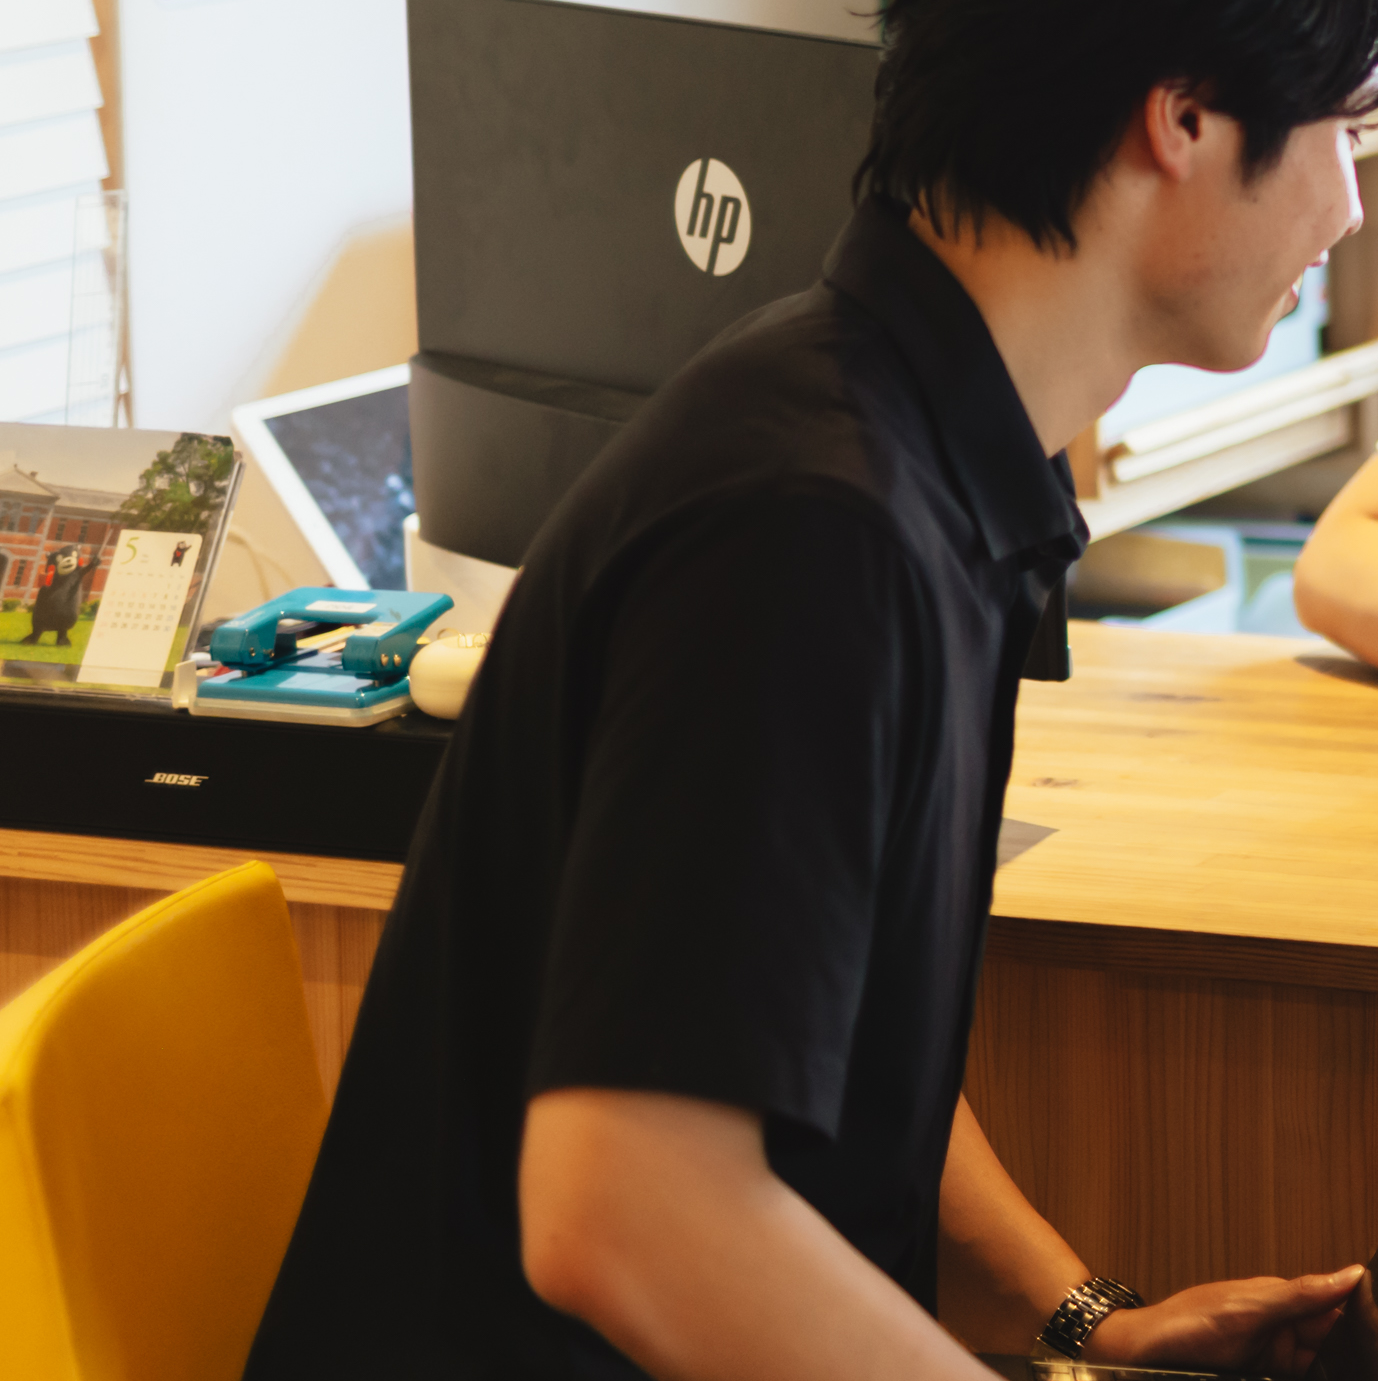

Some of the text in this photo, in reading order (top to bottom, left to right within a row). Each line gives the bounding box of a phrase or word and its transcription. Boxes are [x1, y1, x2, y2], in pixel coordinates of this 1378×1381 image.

[684, 157, 744, 276] hp
[120, 536, 140, 565] 5
[144, 772, 209, 787] BOSE
